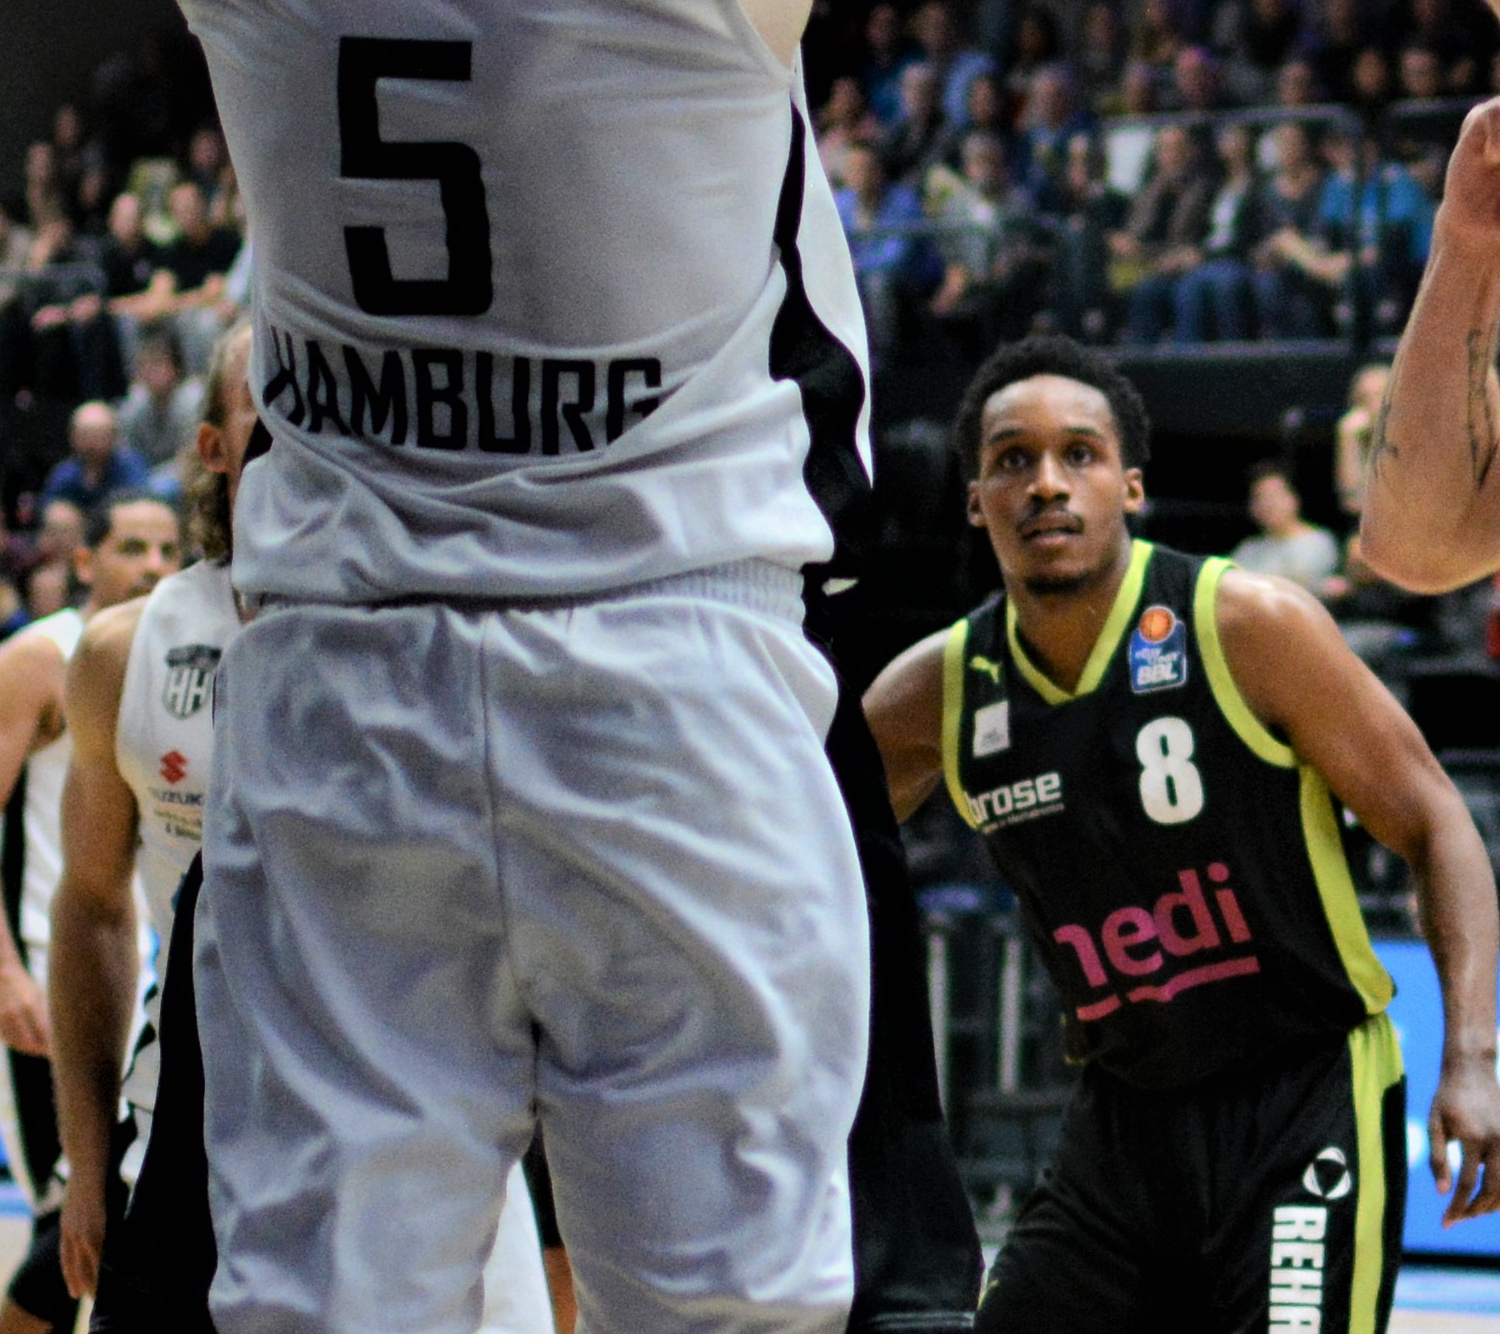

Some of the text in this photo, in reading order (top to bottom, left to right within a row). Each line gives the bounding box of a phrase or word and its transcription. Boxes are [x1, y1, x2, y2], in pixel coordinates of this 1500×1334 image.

[338, 35, 493, 316] 5
[263, 325, 663, 455] HAMBURG
[1135, 715, 1205, 825] 8
